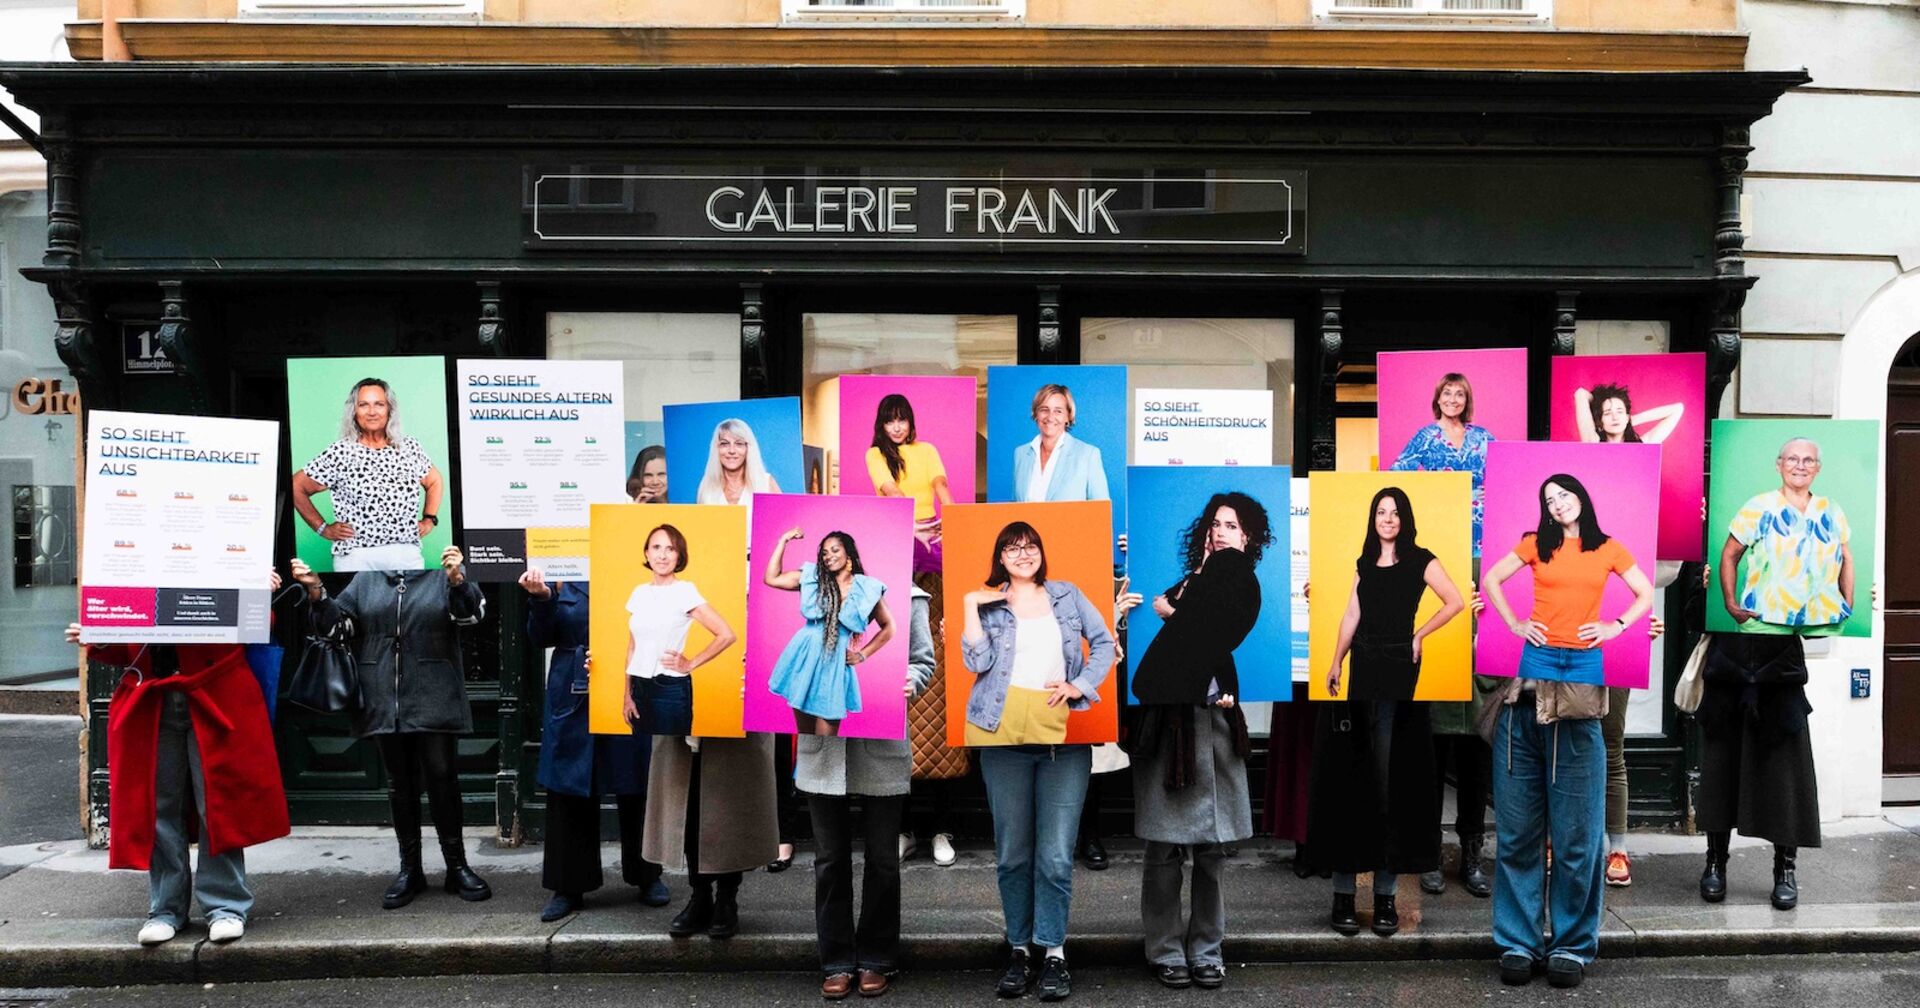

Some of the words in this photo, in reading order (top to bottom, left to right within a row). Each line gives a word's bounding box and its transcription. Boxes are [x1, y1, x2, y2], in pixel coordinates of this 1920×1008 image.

[706, 186, 918, 233] GALERIE
[946, 187, 1120, 234] FRANK
[127, 359, 175, 370] Himmelpfor
[468, 374, 489, 387] SO
[493, 374, 537, 387] SIEHT
[469, 391, 552, 404] GESUNDES
[555, 391, 613, 405] ALTERN
[1144, 401, 1162, 412] SO
[1164, 401, 1200, 413] SIEHT
[470, 408, 544, 421] WIRKLICH
[548, 408, 580, 421] AUS
[1143, 414, 1267, 429] SCHÖNHEITSDRUCK
[101, 427, 127, 441] SO
[132, 428, 186, 444] SIEHT
[1143, 431, 1169, 442] AUS
[100, 444, 261, 465] UNSICHTBARKEIT
[99, 462, 138, 477] AUS
[86, 597, 106, 605] Wer
[110, 605, 133, 613] wird,
[86, 612, 149, 620] verschwindet.
